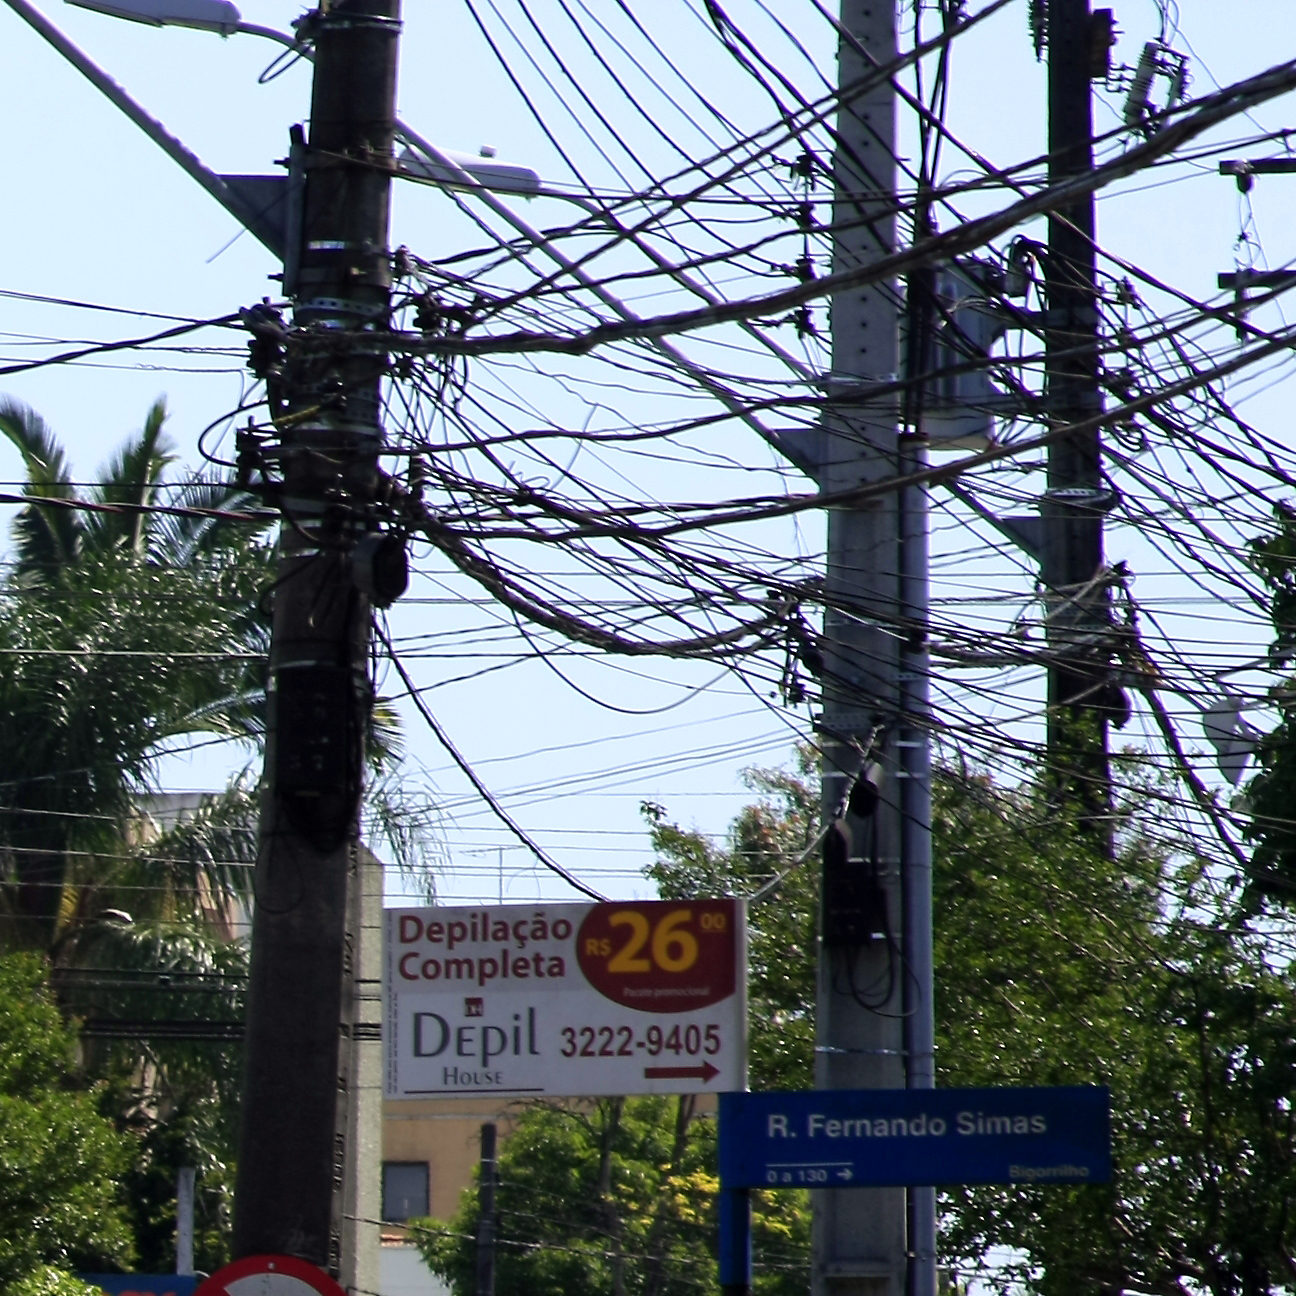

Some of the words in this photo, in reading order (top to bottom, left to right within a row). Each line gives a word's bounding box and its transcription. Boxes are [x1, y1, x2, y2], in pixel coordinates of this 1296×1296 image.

[398, 911, 573, 949] Depilação
[607, 909, 699, 973] 26
[398, 951, 566, 986] Completa
[560, 1024, 721, 1058] 3222-9405
[766, 1113, 798, 1139] R.
[808, 1113, 947, 1138] Fernando
[955, 1111, 1047, 1136] Simas
[797, 1168, 828, 1183] 130
